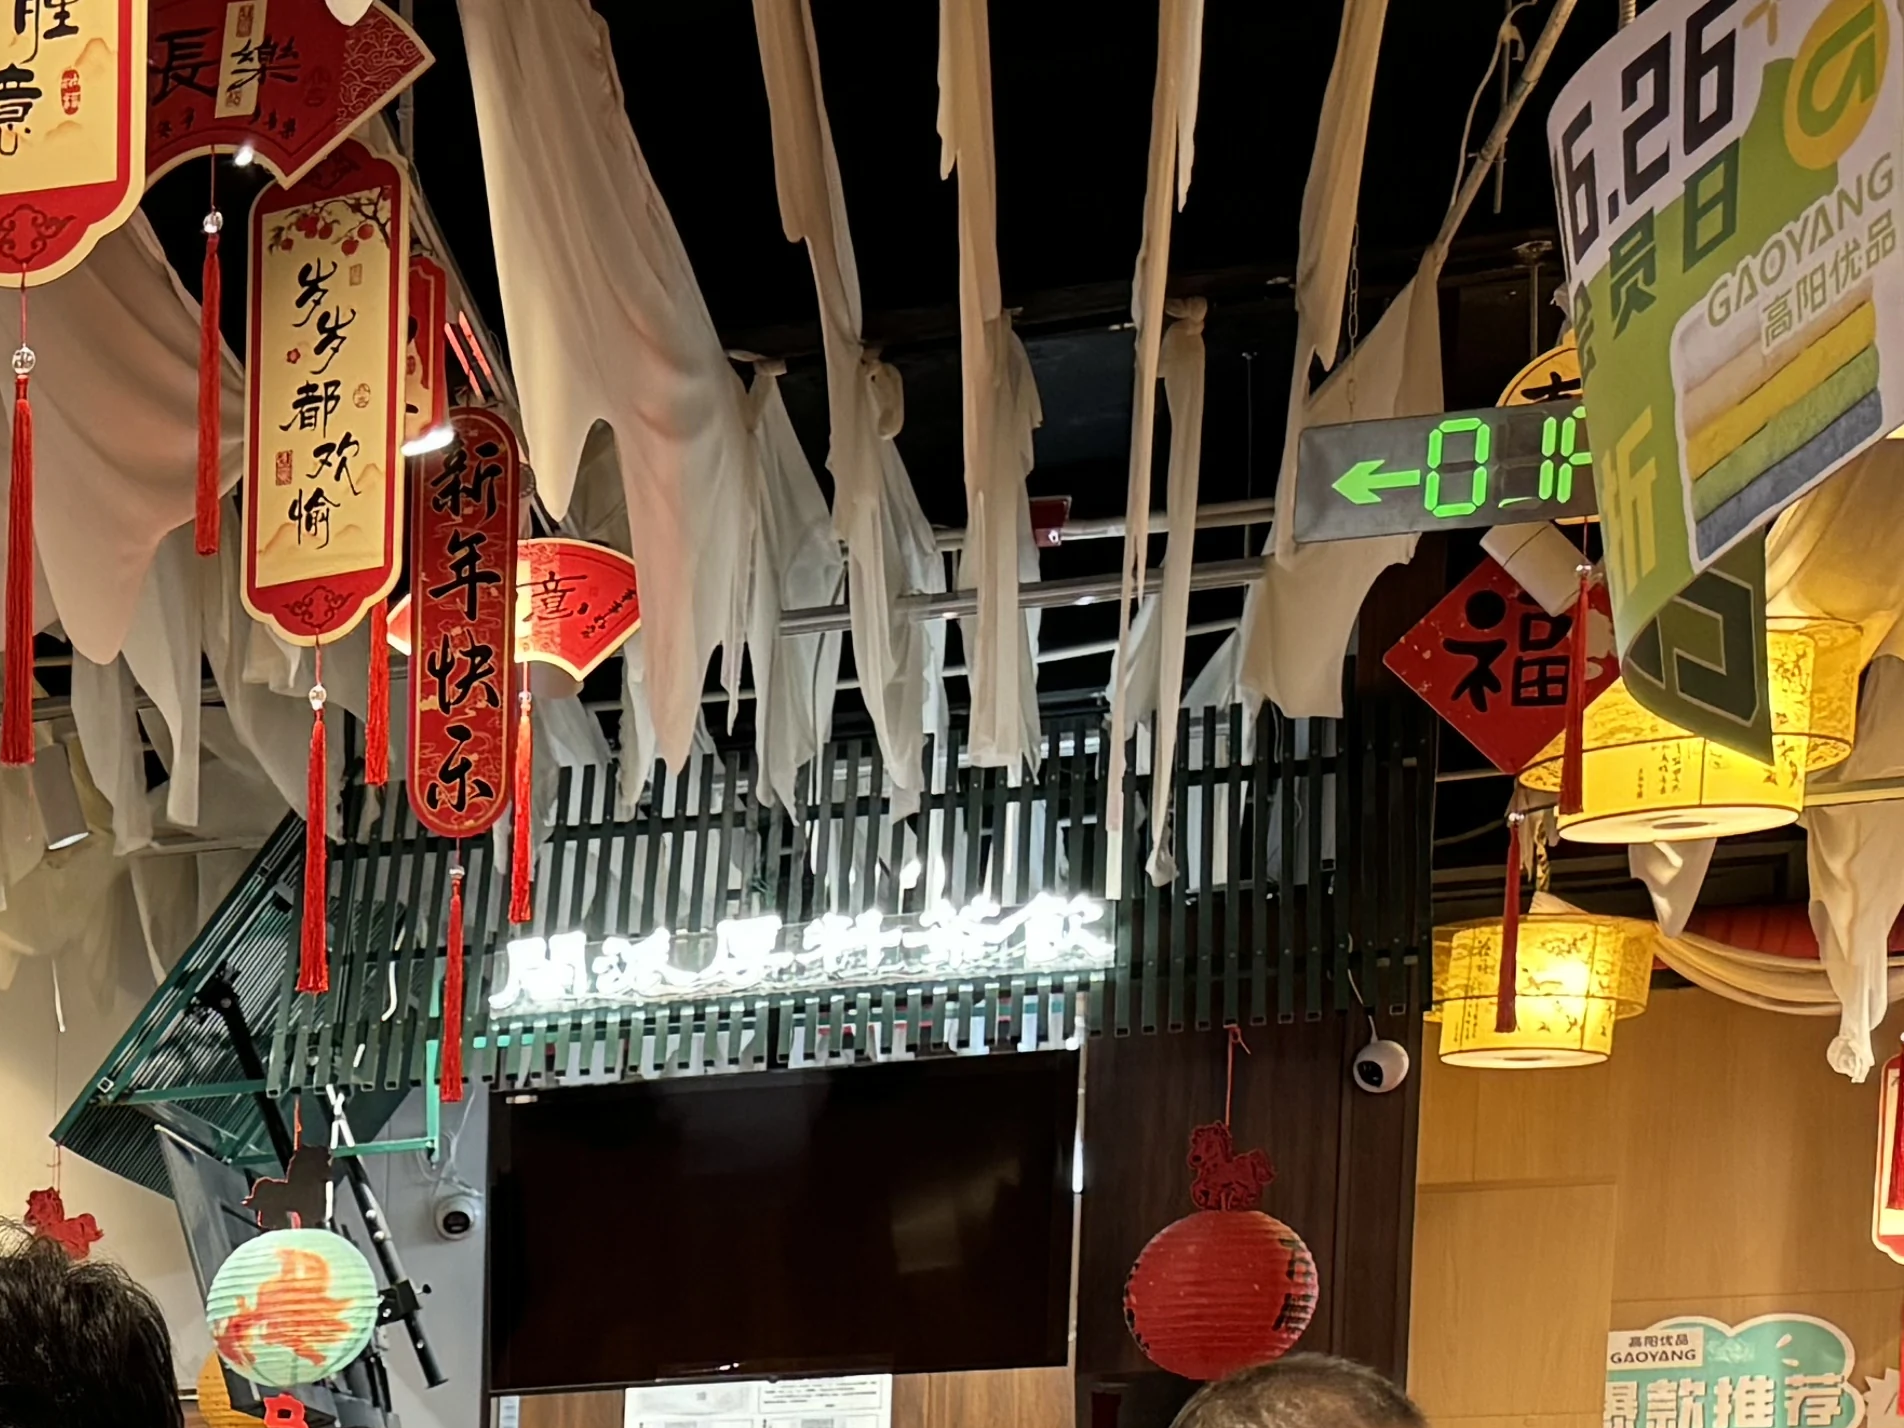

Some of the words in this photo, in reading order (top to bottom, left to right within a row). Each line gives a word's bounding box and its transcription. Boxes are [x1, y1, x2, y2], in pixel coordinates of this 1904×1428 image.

[1562, 0, 1738, 266] 6.26
[1707, 152, 1894, 328] GAOYANG
[1763, 208, 1897, 348] 高阳优品
[278, 257, 362, 549] 岁岁都欢愉
[426, 431, 503, 814] 新年快乐
[1443, 590, 1574, 712] 福
[1609, 1348, 1698, 1365] GAOYANG
